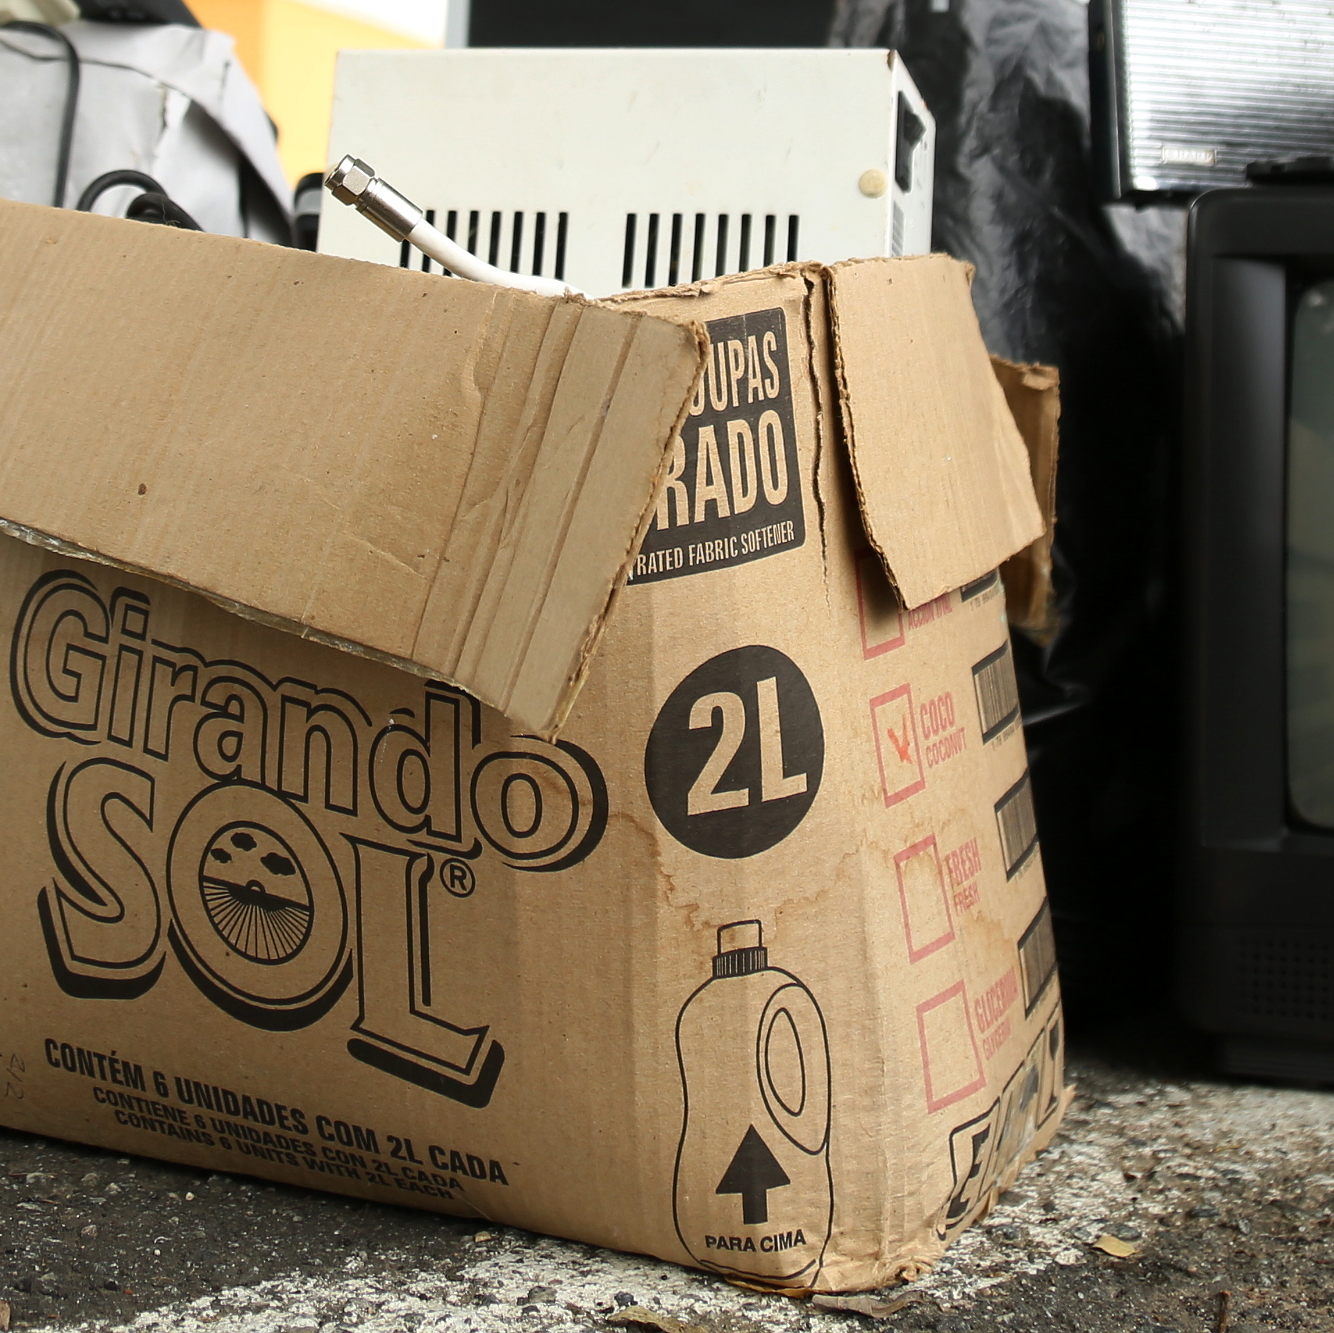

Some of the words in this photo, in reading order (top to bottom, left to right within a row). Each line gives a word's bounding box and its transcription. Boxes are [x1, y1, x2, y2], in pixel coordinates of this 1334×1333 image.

[688, 537, 738, 567] FABRIC
[741, 520, 795, 555] SOFTENER
[10, 569, 608, 872] Girando
[687, 677, 808, 815] 2L
[920, 691, 956, 741] COCO
[925, 726, 968, 768] COCONUT
[945, 837, 982, 887] FRESH
[44, 1037, 147, 1093] CONTÉM
[152, 1070, 169, 1099] 6
[174, 1076, 309, 1136] UNIDADES
[315, 1115, 380, 1155] COM
[386, 1134, 424, 1165] 2L
[428, 1144, 510, 1186] CADA
[93, 1086, 189, 1127] CONTIENE
[193, 1113, 207, 1130] 6
[210, 1116, 317, 1158] UNIDADES
[321, 1146, 367, 1169] CON
[371, 1159, 399, 1176] 2L
[402, 1166, 465, 1192] CADA
[114, 1110, 217, 1146] CONTAINS
[219, 1135, 233, 1151] 6
[235, 1139, 298, 1166] UNITS
[301, 1156, 362, 1180] WITH
[365, 1171, 392, 1187] 2L
[393, 1177, 455, 1200] EACH
[705, 1235, 757, 1253] PARA
[760, 1228, 807, 1253] CIMA
